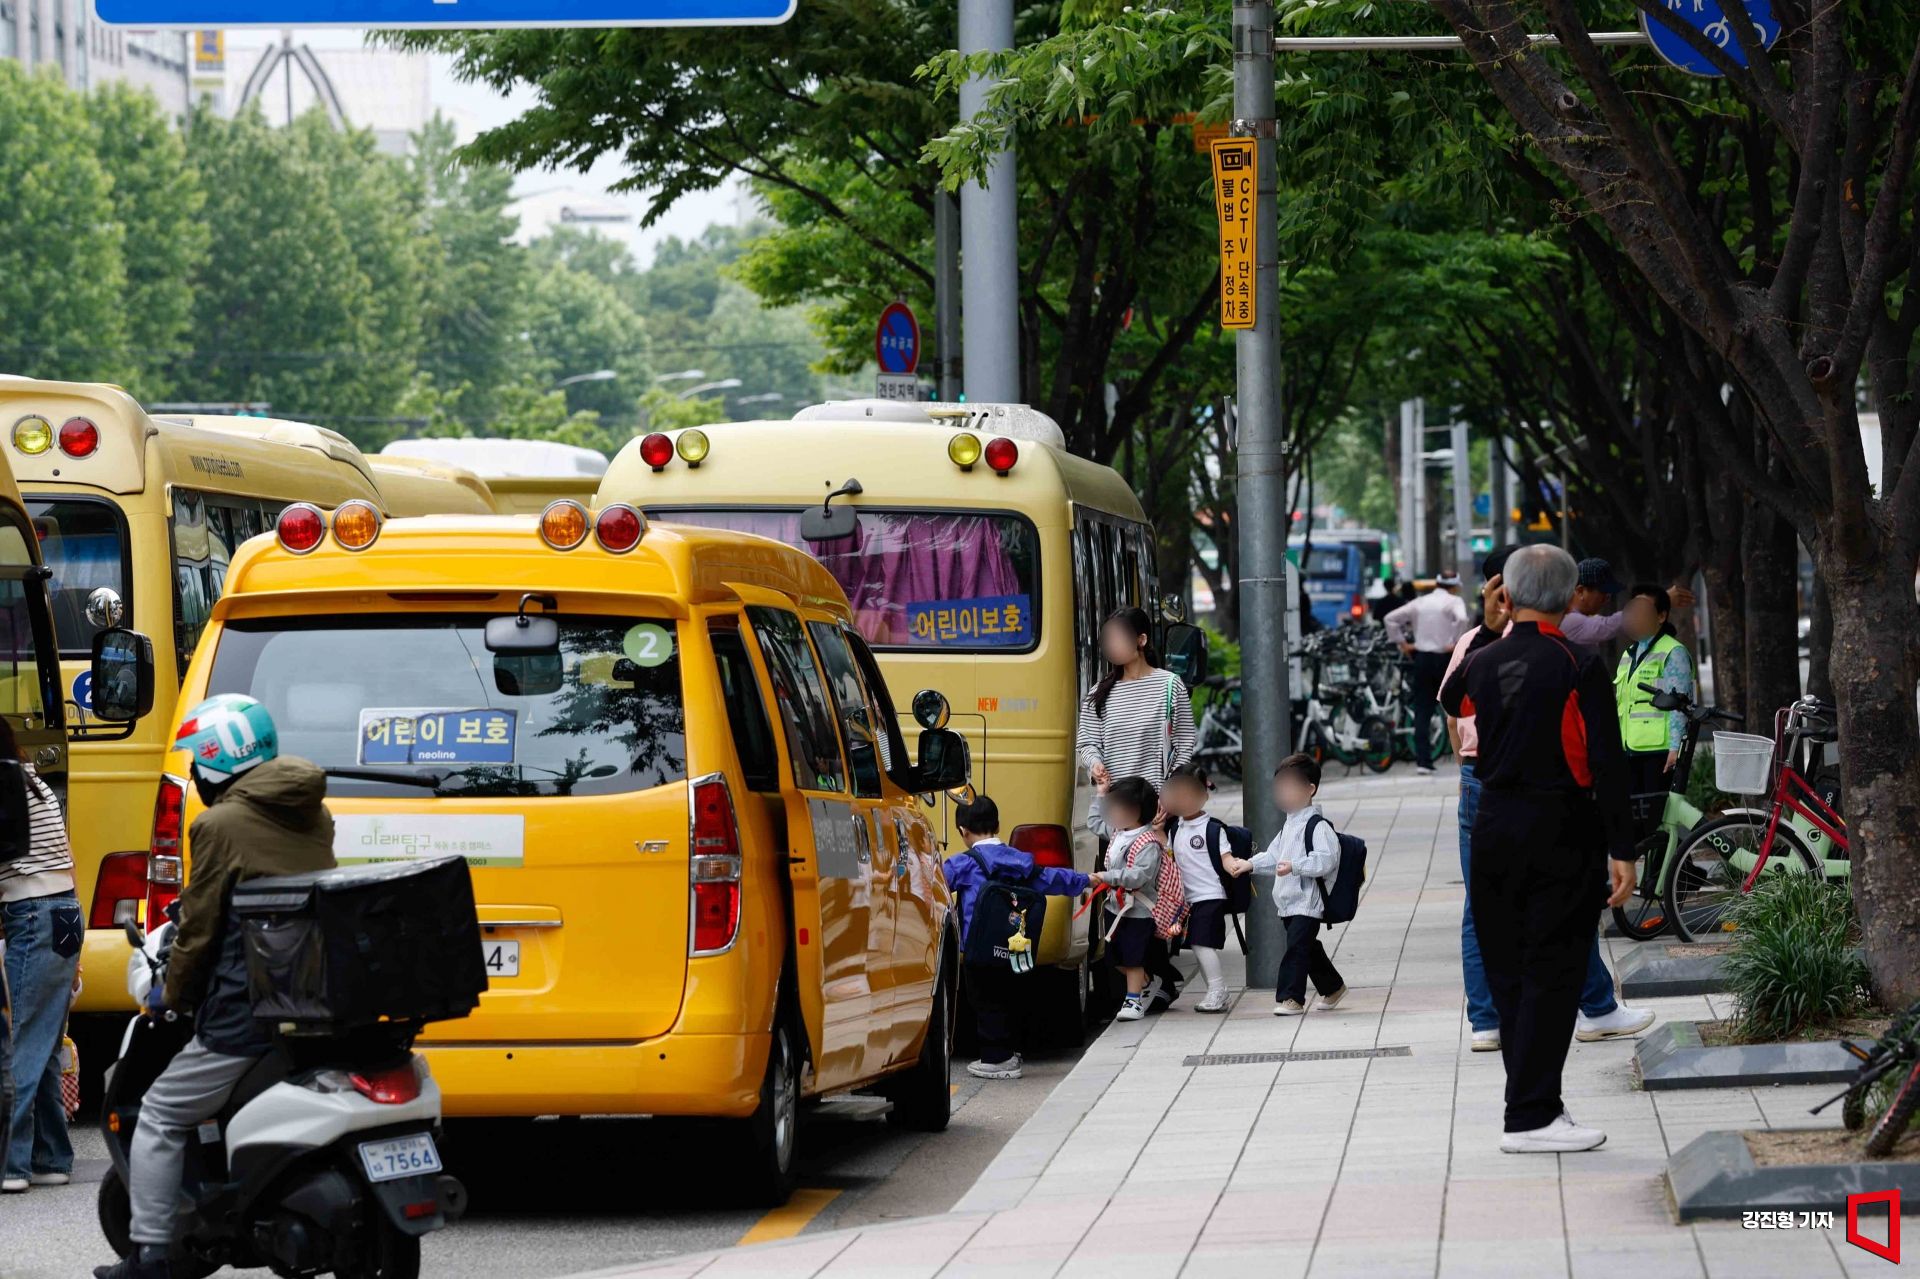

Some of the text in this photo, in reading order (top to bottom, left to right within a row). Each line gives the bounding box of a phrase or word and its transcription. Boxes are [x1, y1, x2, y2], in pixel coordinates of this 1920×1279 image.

[1222, 178, 1234, 222] 불법
[879, 382, 915, 399] 견인지역
[638, 631, 658, 658] 2
[977, 697, 998, 712] NEW
[367, 717, 510, 746] 어린이 보호
[418, 750, 456, 760] neoline
[361, 825, 431, 856] 미래탐구
[384, 1149, 433, 1172] 7564
